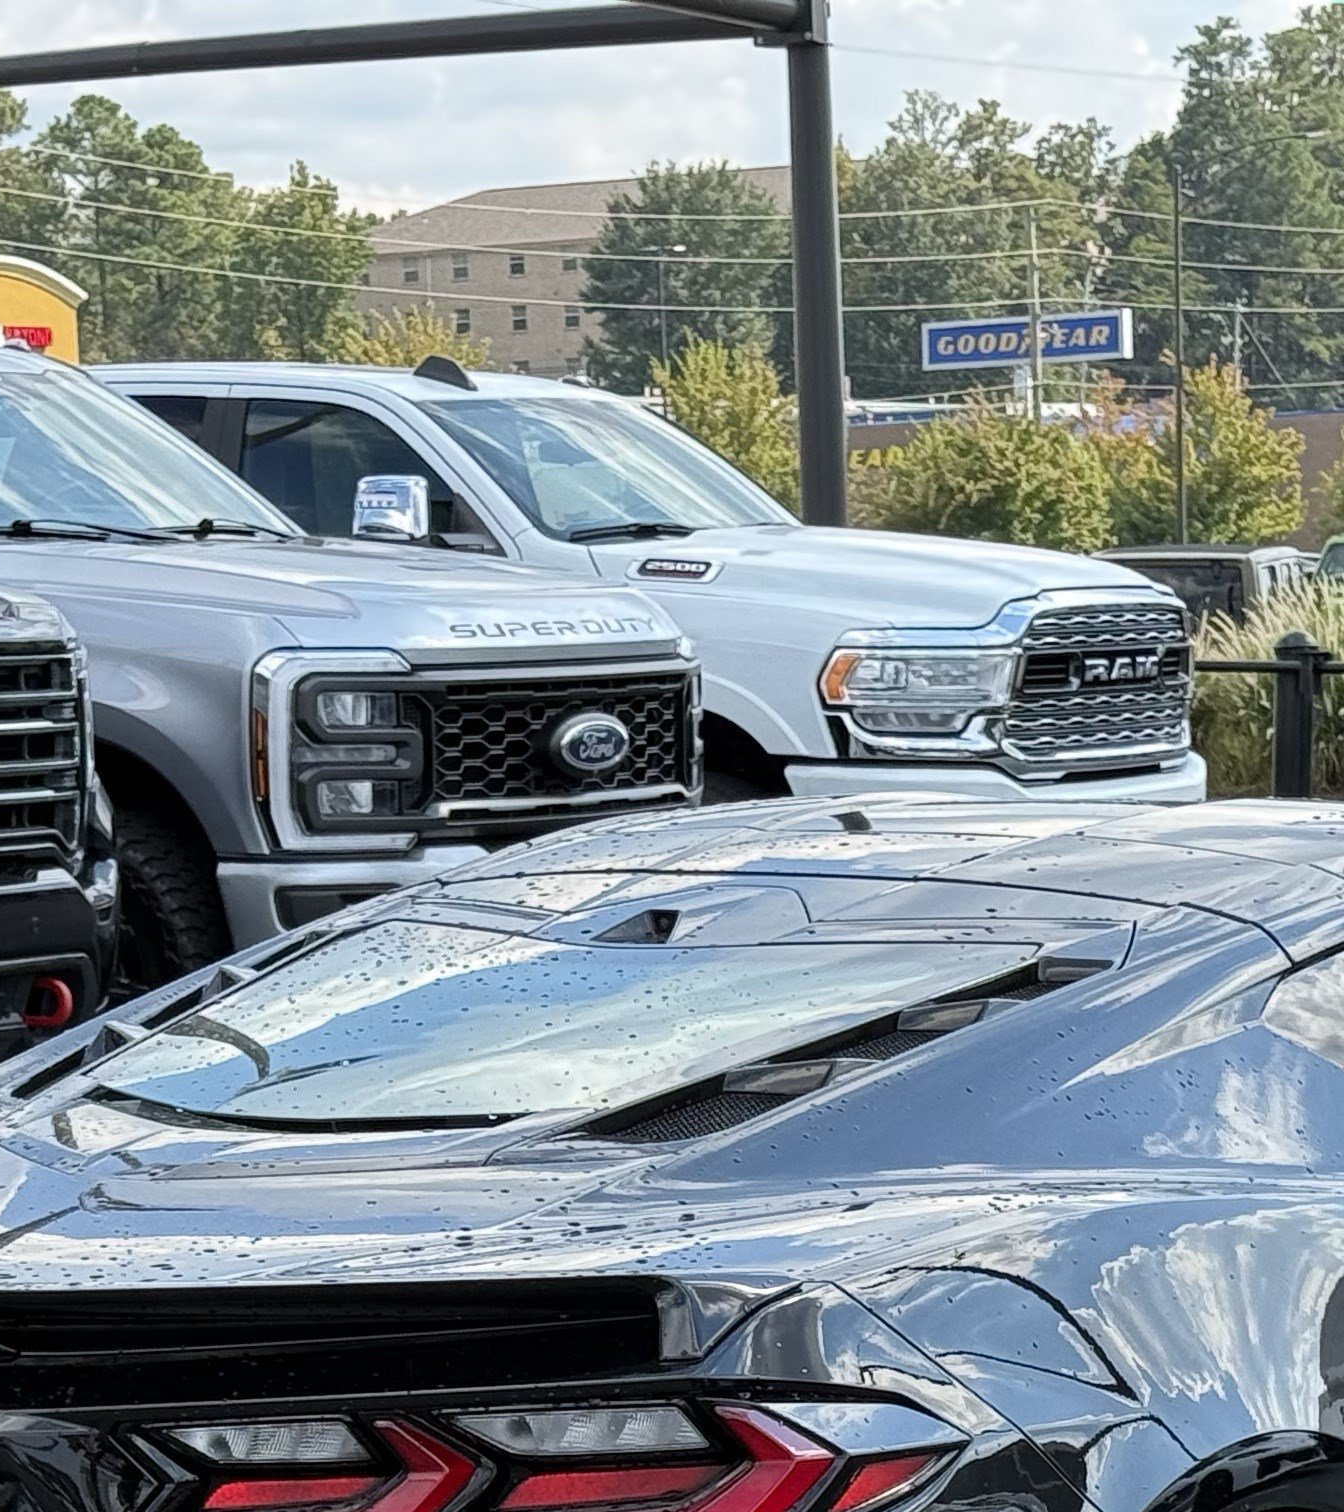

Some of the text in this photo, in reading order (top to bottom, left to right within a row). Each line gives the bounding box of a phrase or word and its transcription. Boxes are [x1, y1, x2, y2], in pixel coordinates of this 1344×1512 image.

[645, 561, 707, 573] 2500
[1084, 656, 1159, 681] RAM
[579, 731, 616, 760] Ford
